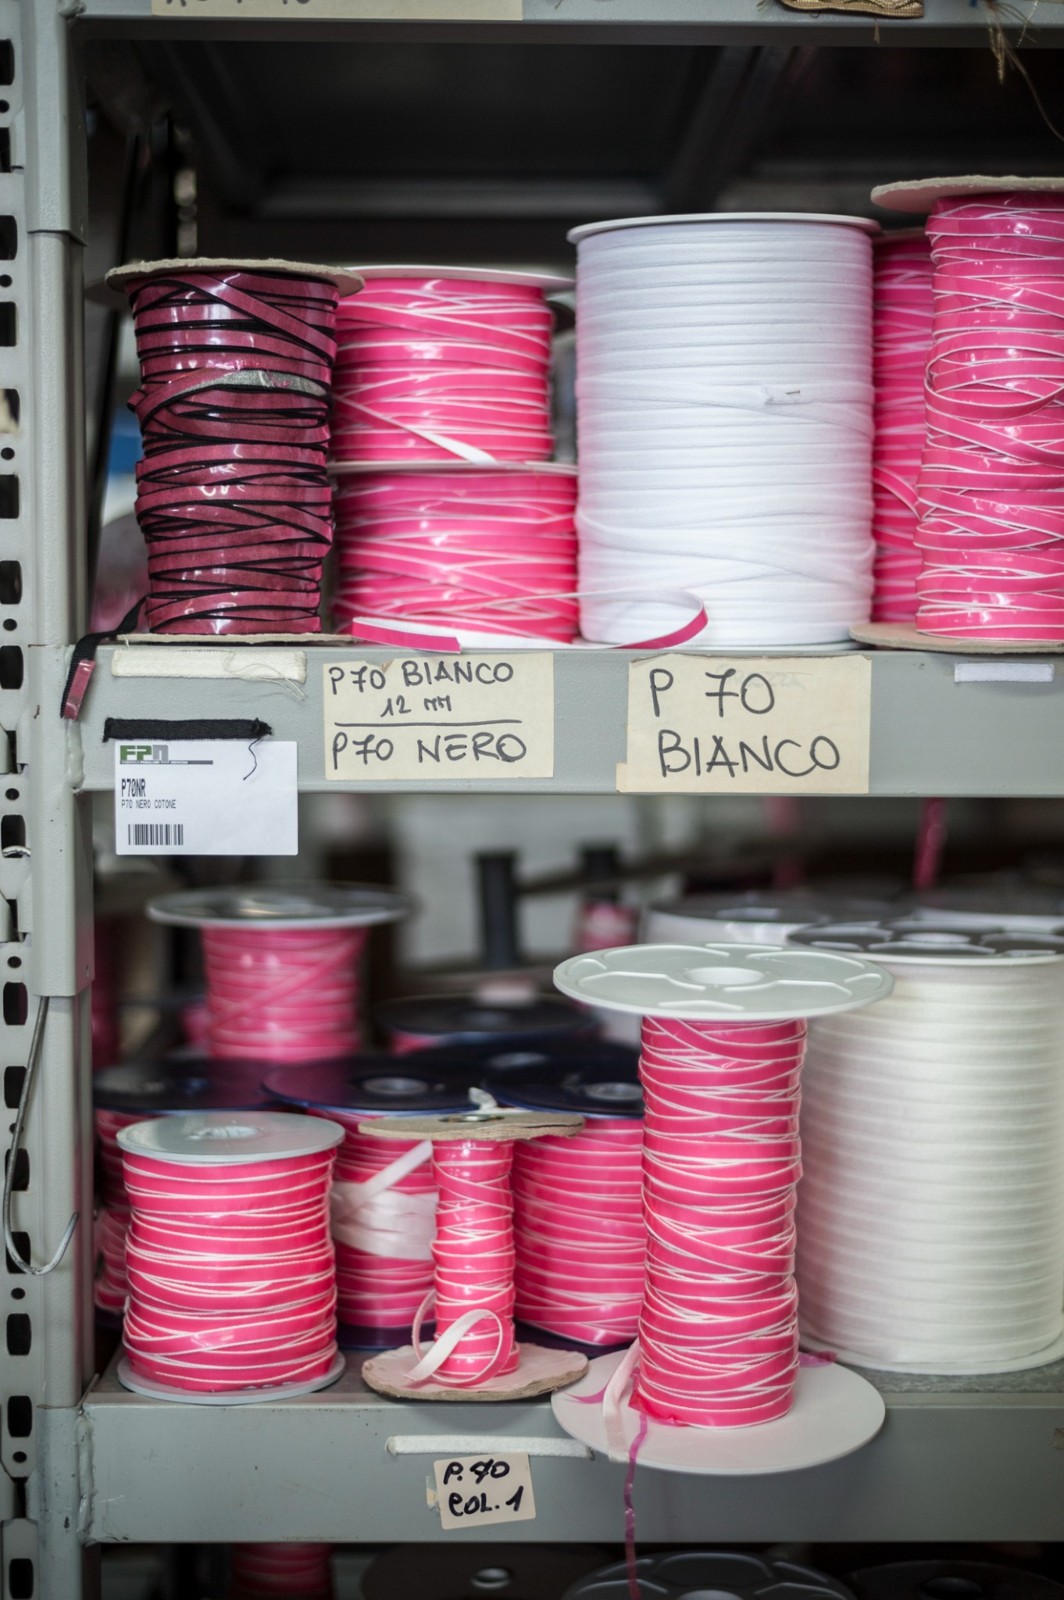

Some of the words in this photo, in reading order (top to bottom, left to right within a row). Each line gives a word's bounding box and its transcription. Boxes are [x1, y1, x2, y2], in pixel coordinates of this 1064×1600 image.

[328, 666, 386, 695] P70
[401, 660, 514, 687] BIANCO
[649, 668, 674, 717] P
[704, 668, 775, 717] 70
[380, 695, 412, 717] 12
[331, 731, 394, 770] P70
[416, 731, 527, 763] NERO
[657, 729, 841, 777] BIANCO
[121, 778, 146, 797] P70NR
[121, 799, 132, 809] P70
[136, 799, 151, 809] NERO
[154, 799, 177, 809] COTONE
